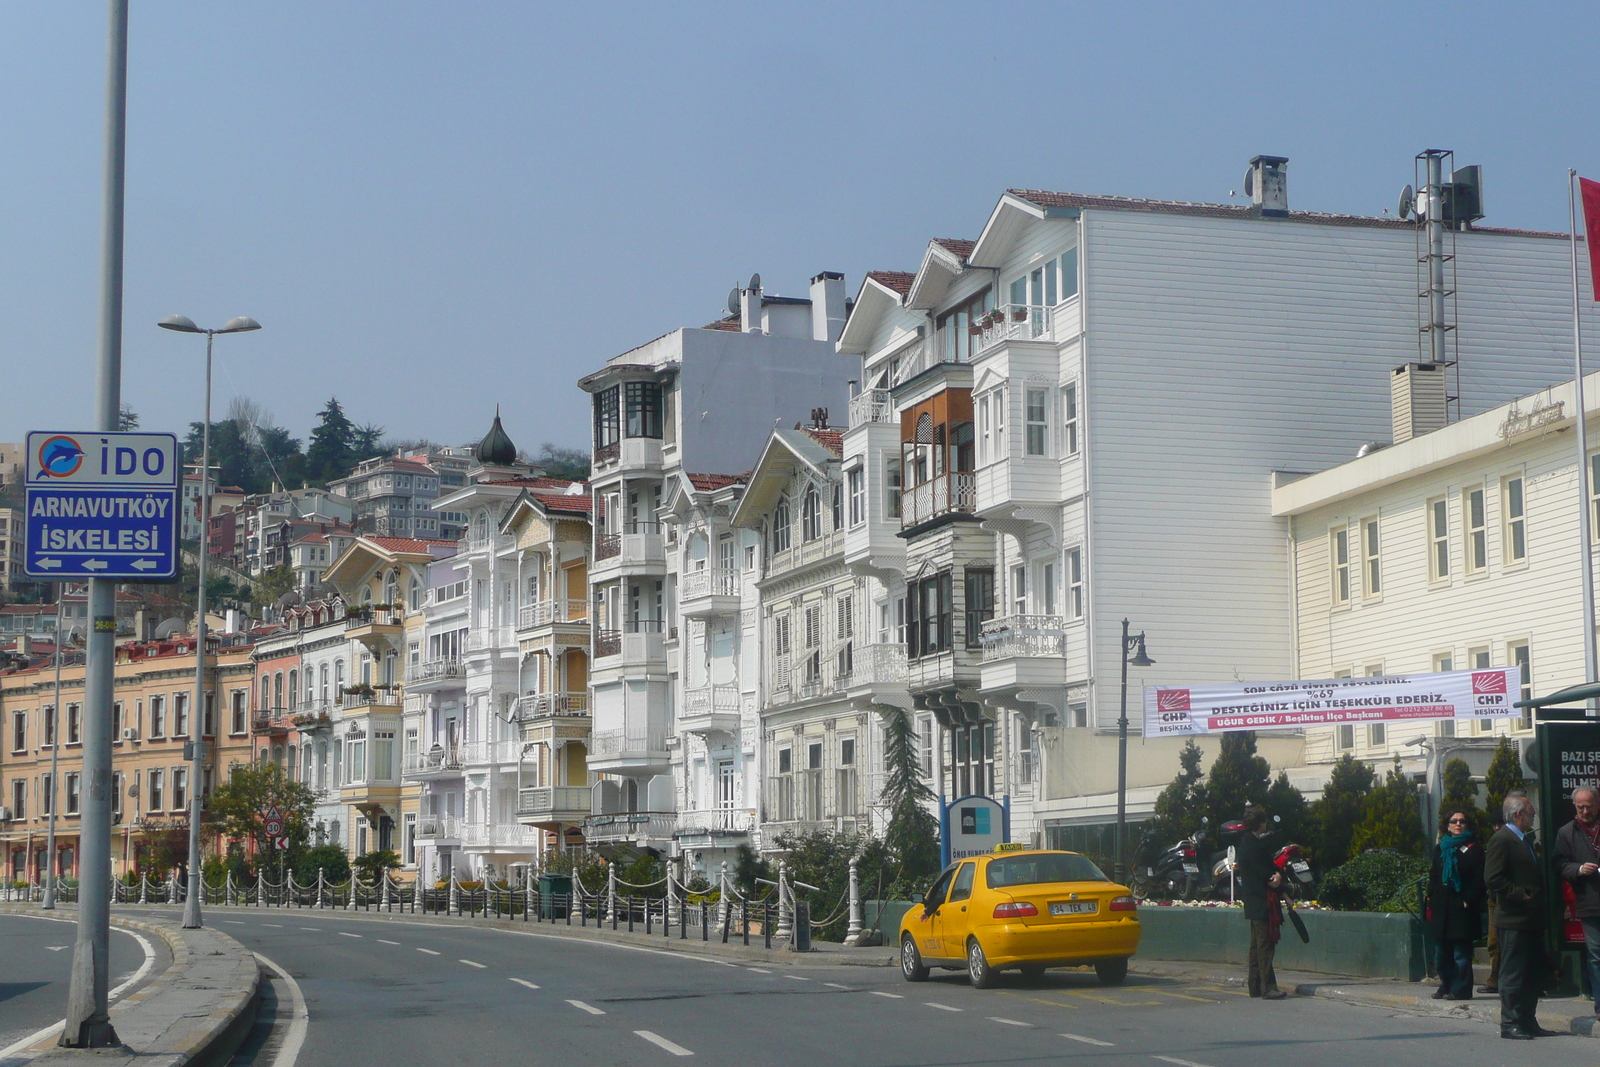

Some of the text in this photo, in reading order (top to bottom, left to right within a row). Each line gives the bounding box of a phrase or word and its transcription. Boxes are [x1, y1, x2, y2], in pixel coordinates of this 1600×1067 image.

[101, 438, 165, 476] İDO
[31, 494, 169, 519] ARNAVUTKÖY
[41, 523, 159, 551] İSKELESİ
[1307, 689, 1334, 699] %69
[1211, 691, 1447, 715] DESTEĞİNİZ İÇİN TEŞEKKÜR EDERİZ.
[1477, 695, 1503, 705] CHP
[1474, 707, 1509, 716] BEŞİKTAŞ
[1162, 712, 1187, 722] CHP
[1216, 717, 1244, 727] UĞUR
[1246, 715, 1276, 725] GEDİK
[1285, 713, 1325, 724] Beşiktaş
[1346, 711, 1383, 720] Başkanı
[1159, 724, 1193, 733] BEŞİKTAŞ
[1561, 751, 1586, 762] BAZI
[1561, 764, 1598, 775] KALICI
[268, 824, 279, 832] 30
[1054, 904, 1064, 913] 34
[1068, 903, 1082, 912] TEK
